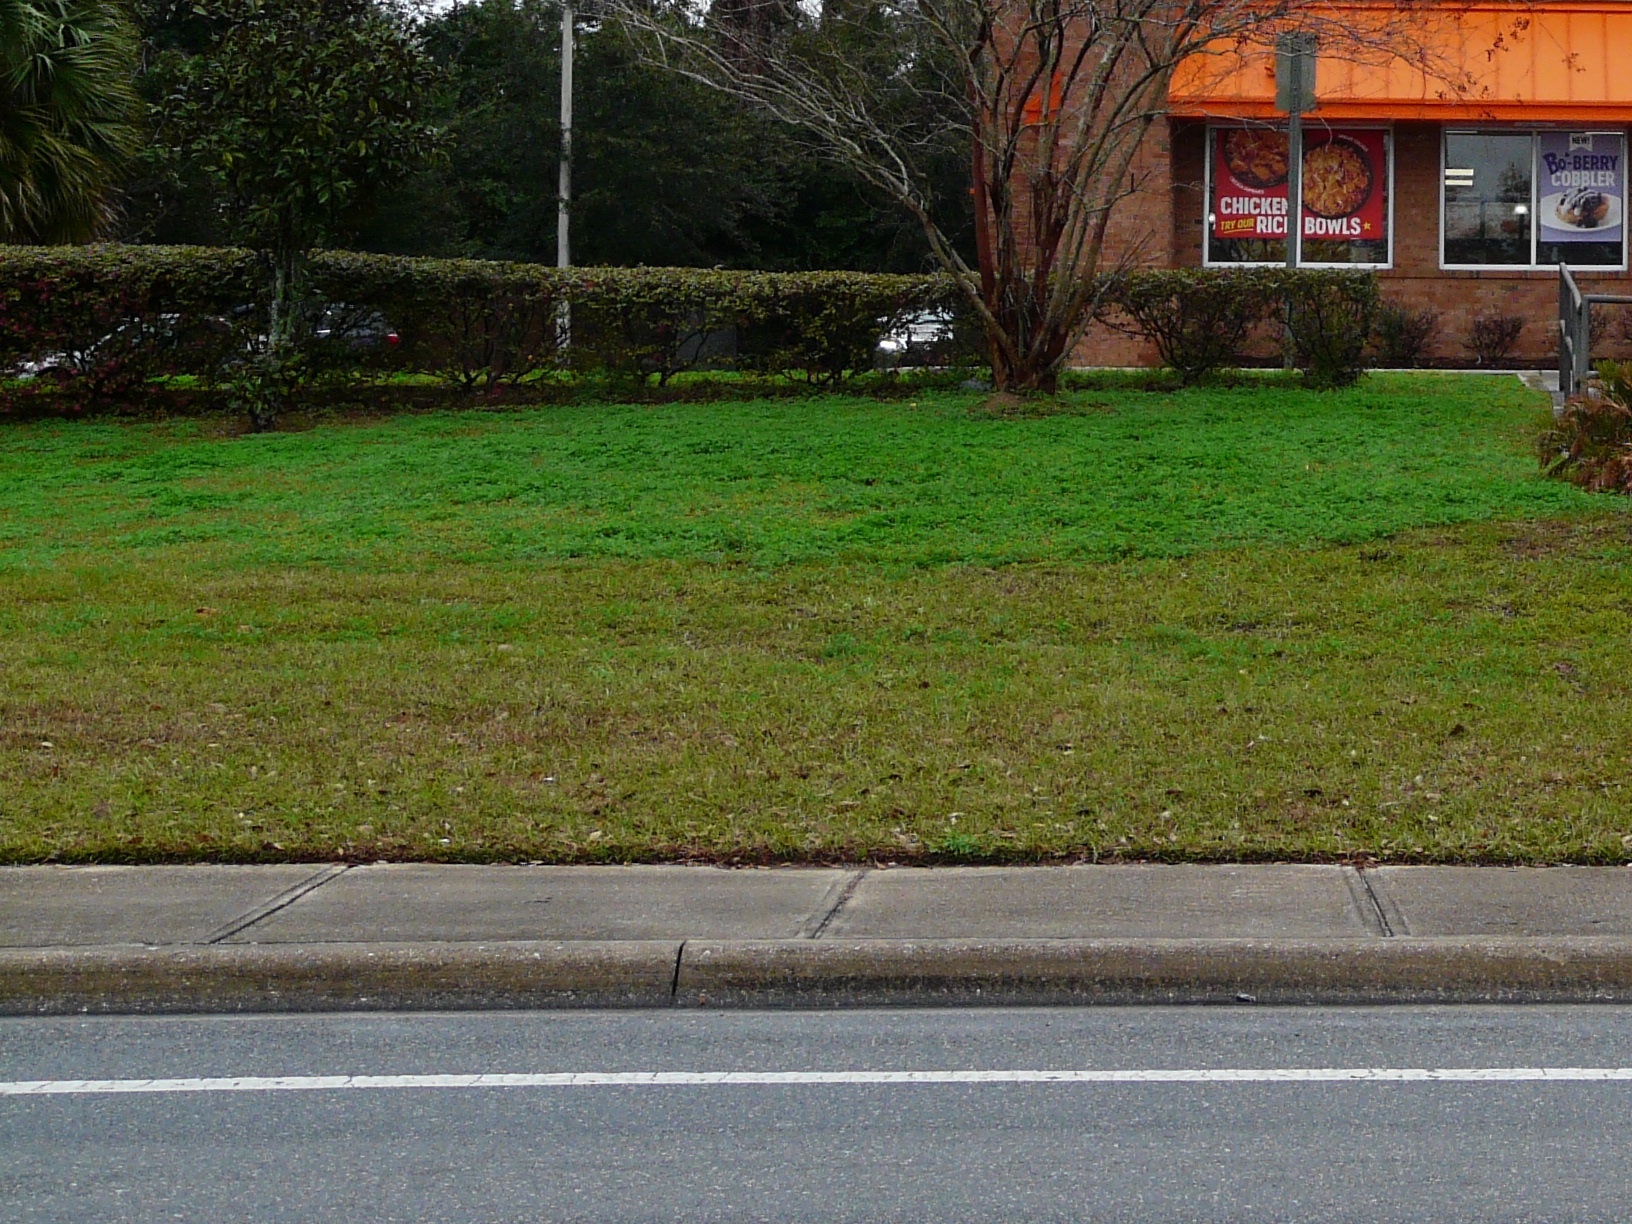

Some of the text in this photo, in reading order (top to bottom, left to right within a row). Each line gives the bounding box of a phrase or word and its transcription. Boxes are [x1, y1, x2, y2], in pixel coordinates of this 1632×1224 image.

[1551, 170, 1616, 187] COBBLER
[1221, 220, 1236, 230] TRY
[1237, 218, 1255, 228] OUR
[1304, 216, 1361, 235] BOWLS
